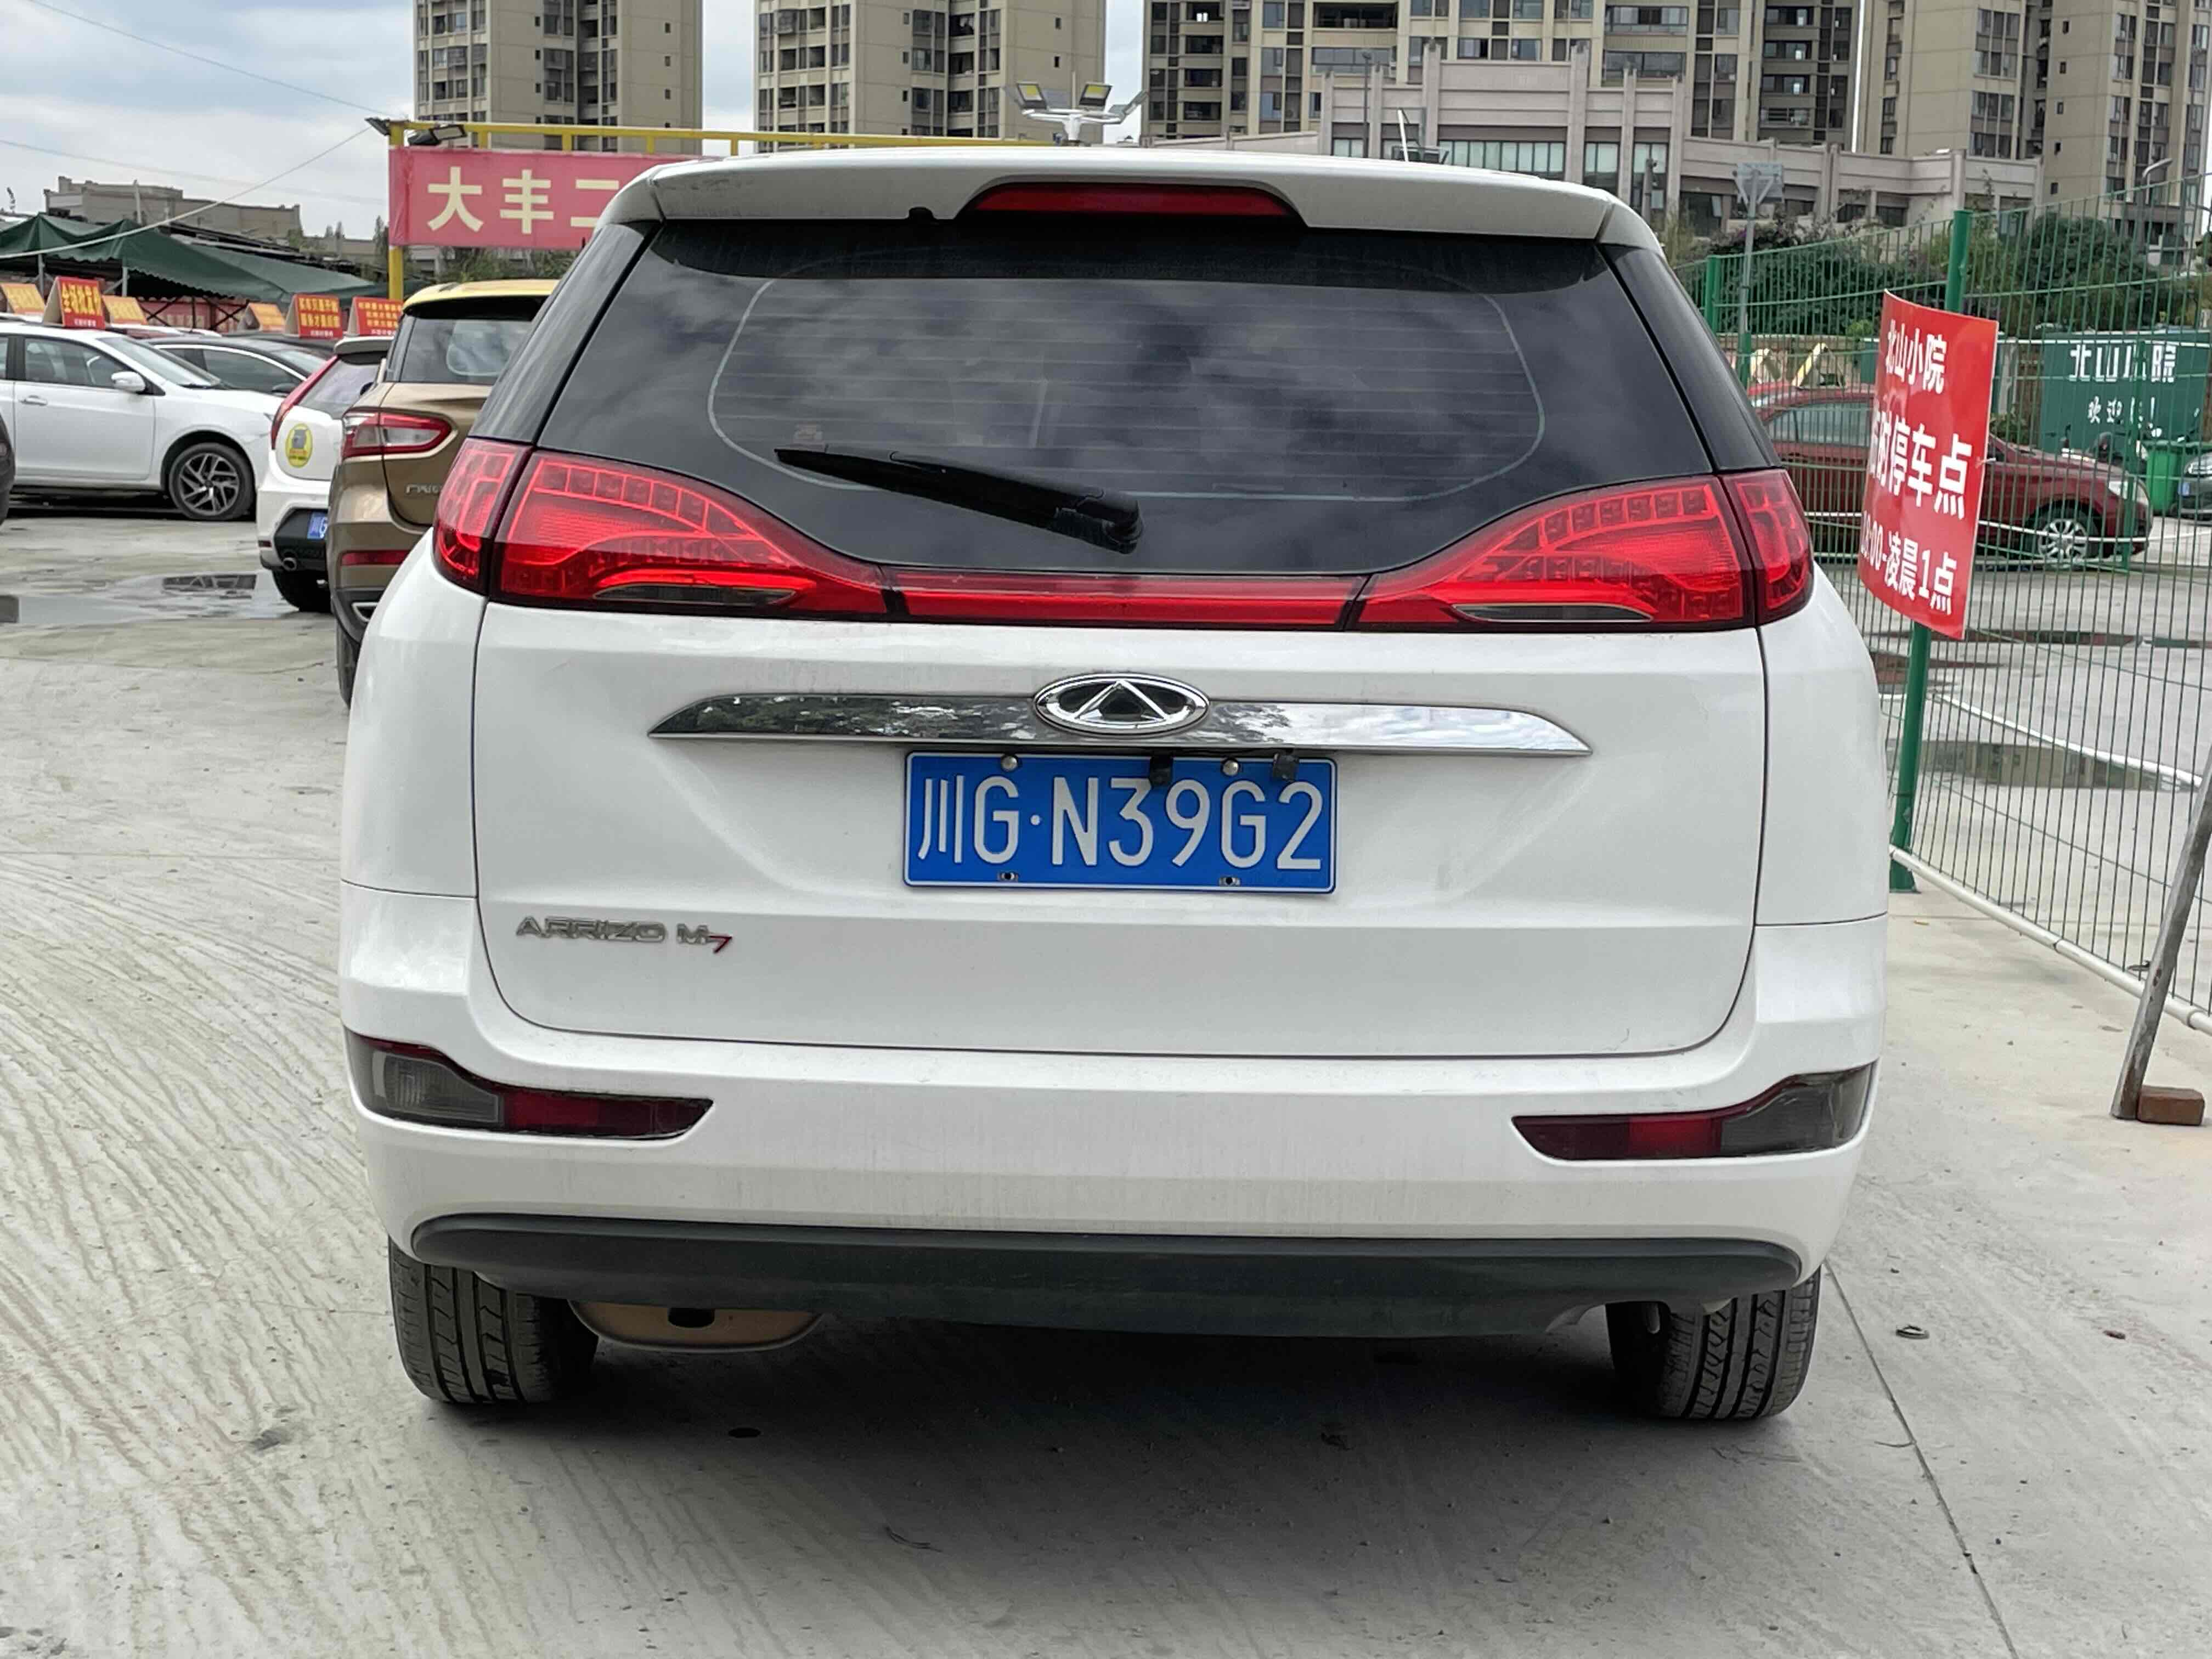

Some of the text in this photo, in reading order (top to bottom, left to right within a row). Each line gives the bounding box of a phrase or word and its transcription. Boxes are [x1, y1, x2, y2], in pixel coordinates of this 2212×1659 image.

[427, 166, 619, 234] 大丰二
[1886, 318, 1947, 394] 北山小院
[516, 916, 733, 954] ARRIZO M7
